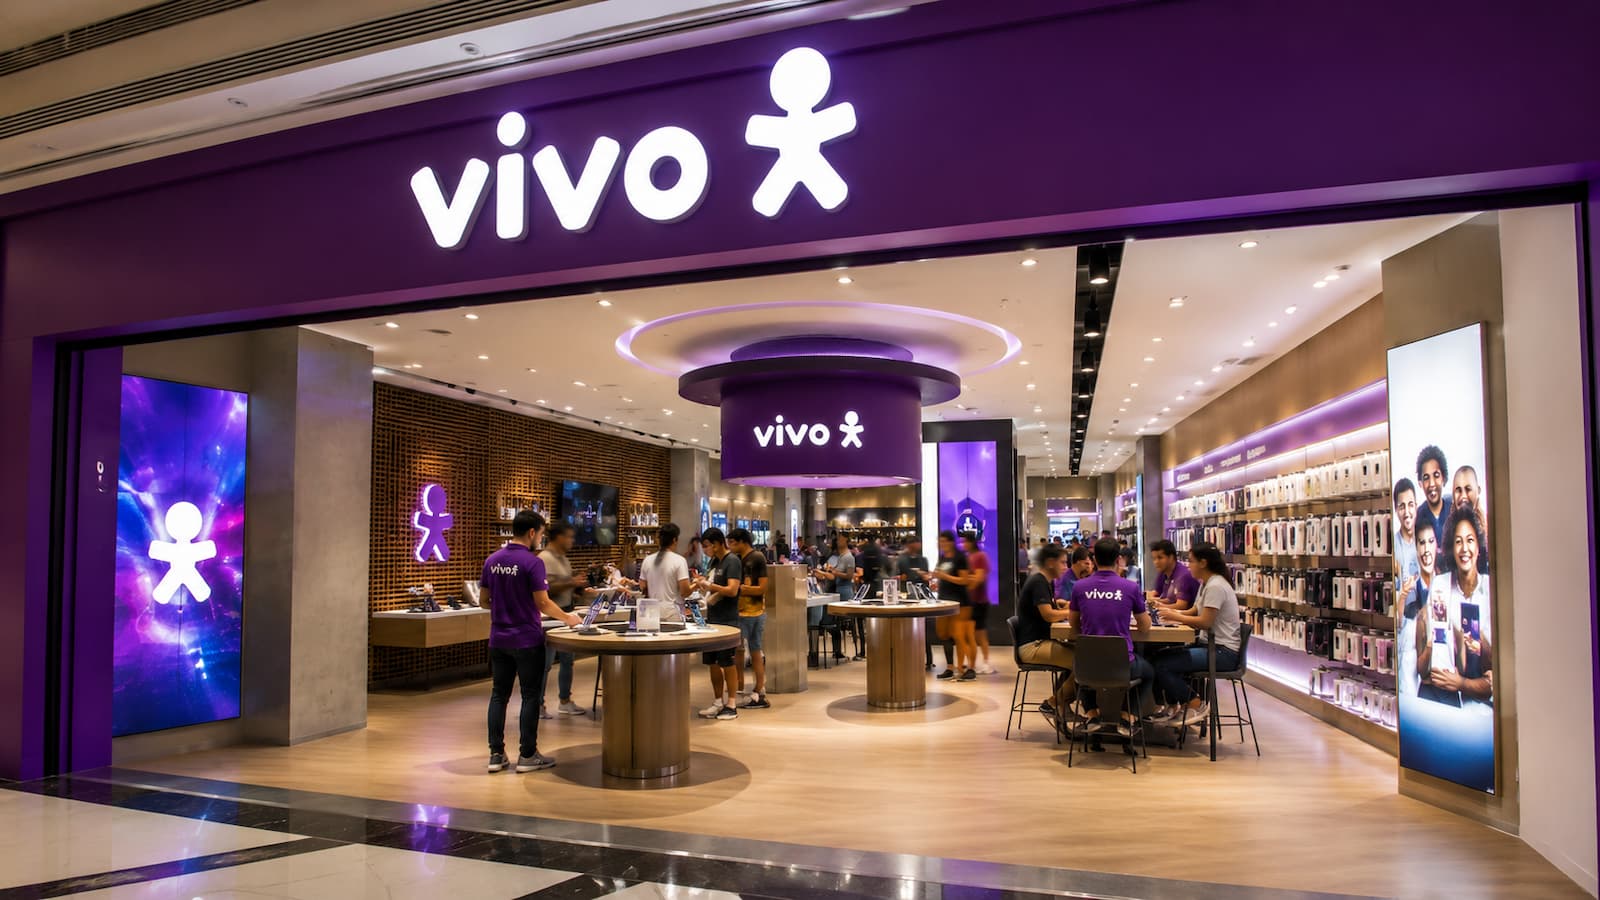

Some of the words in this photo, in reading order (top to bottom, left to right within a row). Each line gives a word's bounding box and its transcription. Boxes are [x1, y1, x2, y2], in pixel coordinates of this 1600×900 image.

[410, 111, 710, 248] vivo
[753, 415, 831, 447] vivo
[490, 563, 511, 574] vivo
[1085, 588, 1114, 599] vivo
